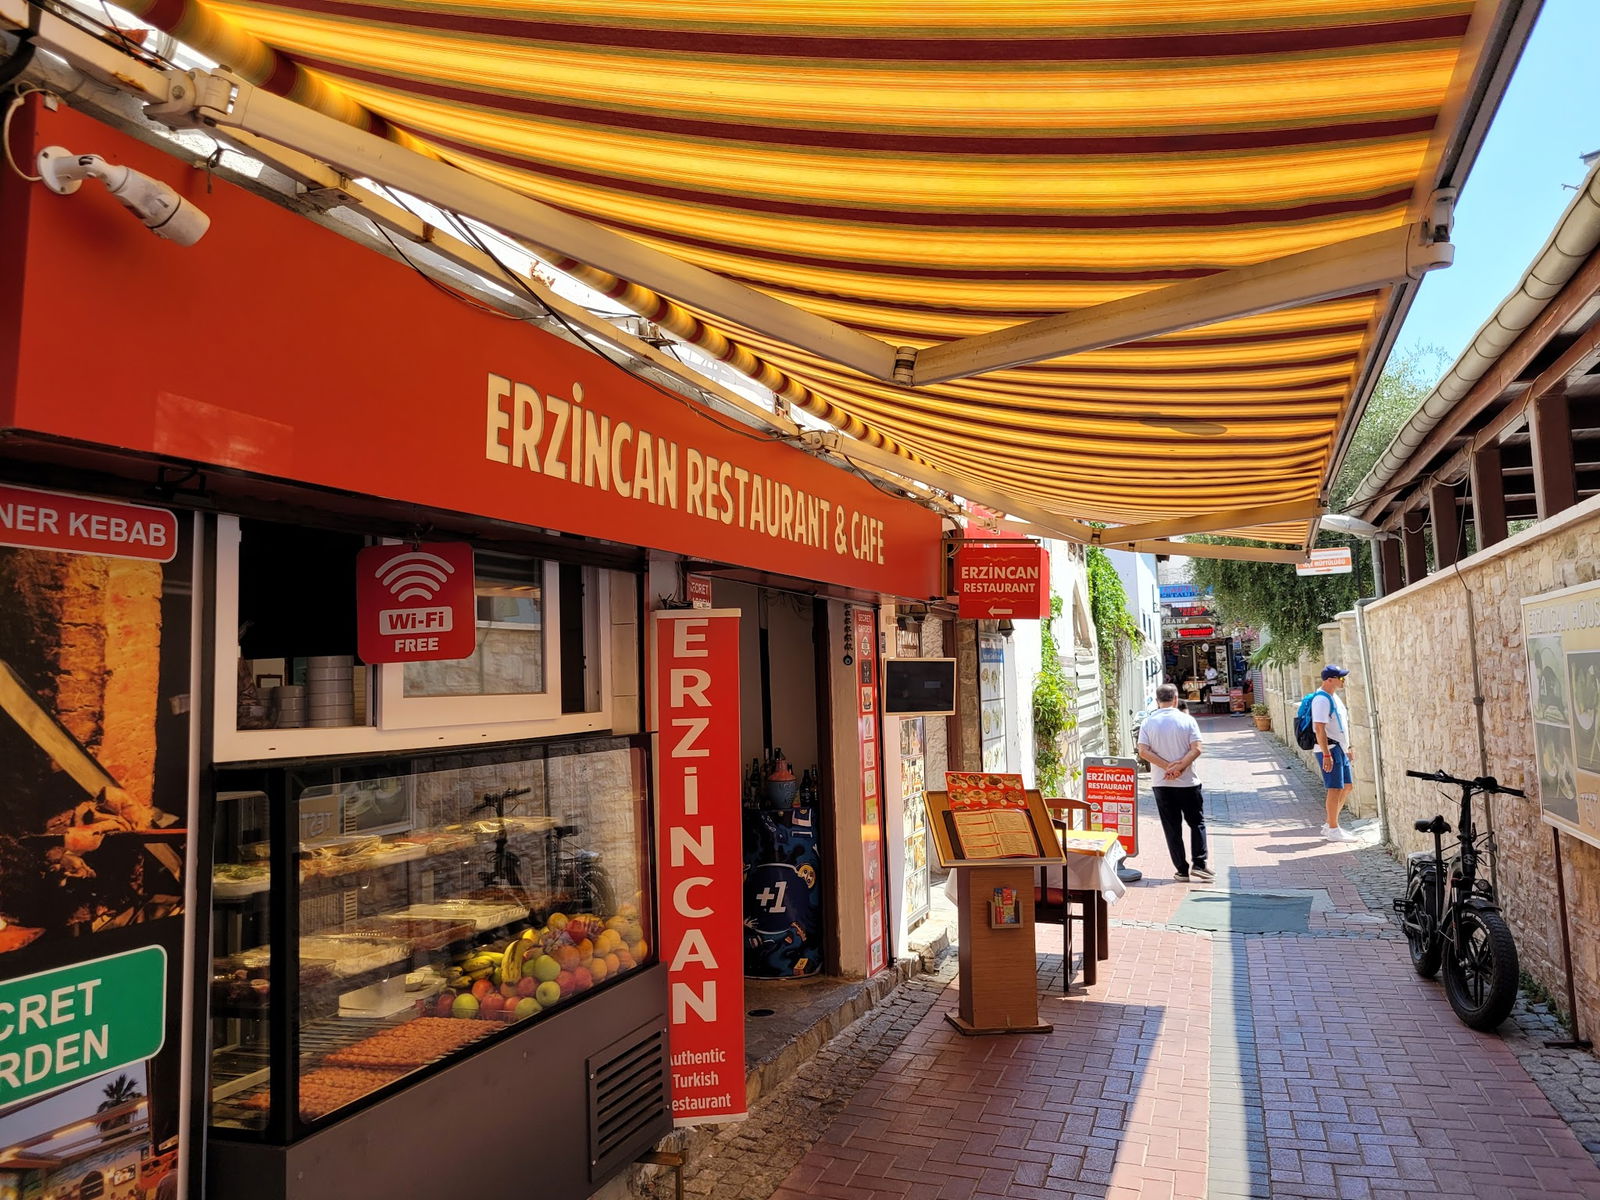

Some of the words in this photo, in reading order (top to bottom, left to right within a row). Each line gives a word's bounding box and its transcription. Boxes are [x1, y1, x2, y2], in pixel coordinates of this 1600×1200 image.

[485, 372, 679, 510] ERZİNCAN
[686, 447, 831, 551] RESTAURANT
[833, 504, 848, 555] &
[850, 510, 886, 567] CAFE
[69, 511, 167, 547] KEBAB
[961, 563, 1039, 579] ERZİNCAN
[963, 583, 1036, 593] RESTAURANT
[388, 611, 445, 630] Wi-Fi
[394, 637, 439, 653] FREE
[1086, 771, 1135, 783] ERZİNCAN
[1087, 782, 1133, 791] RESTAURANT
[672, 1071, 719, 1089] Turkish
[671, 1093, 732, 1111] estaurant
